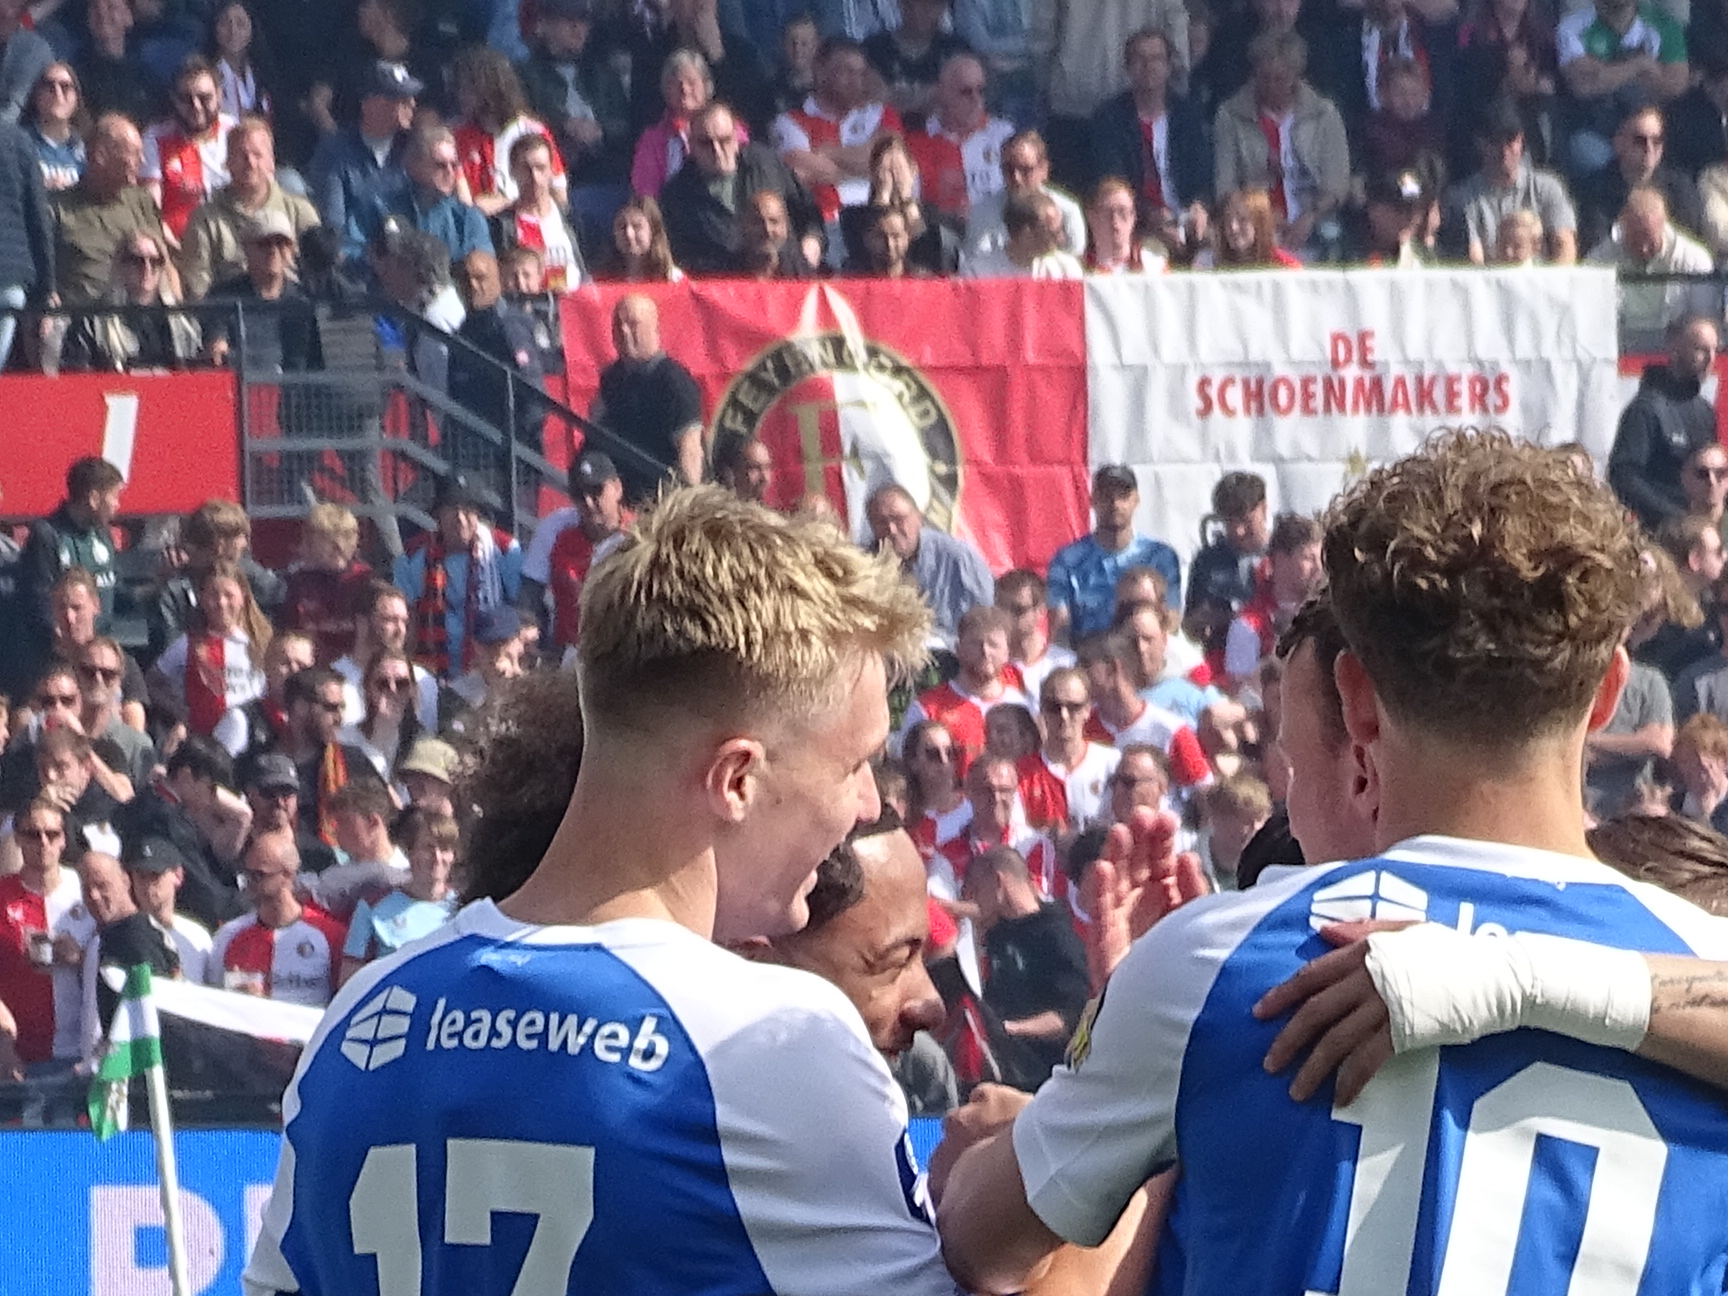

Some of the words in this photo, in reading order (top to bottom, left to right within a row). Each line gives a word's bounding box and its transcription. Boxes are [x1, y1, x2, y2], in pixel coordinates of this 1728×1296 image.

[1329, 330, 1376, 371] DE
[1195, 372, 1511, 418] SCHOENMAKERS
[426, 997, 669, 1073] leaseweb
